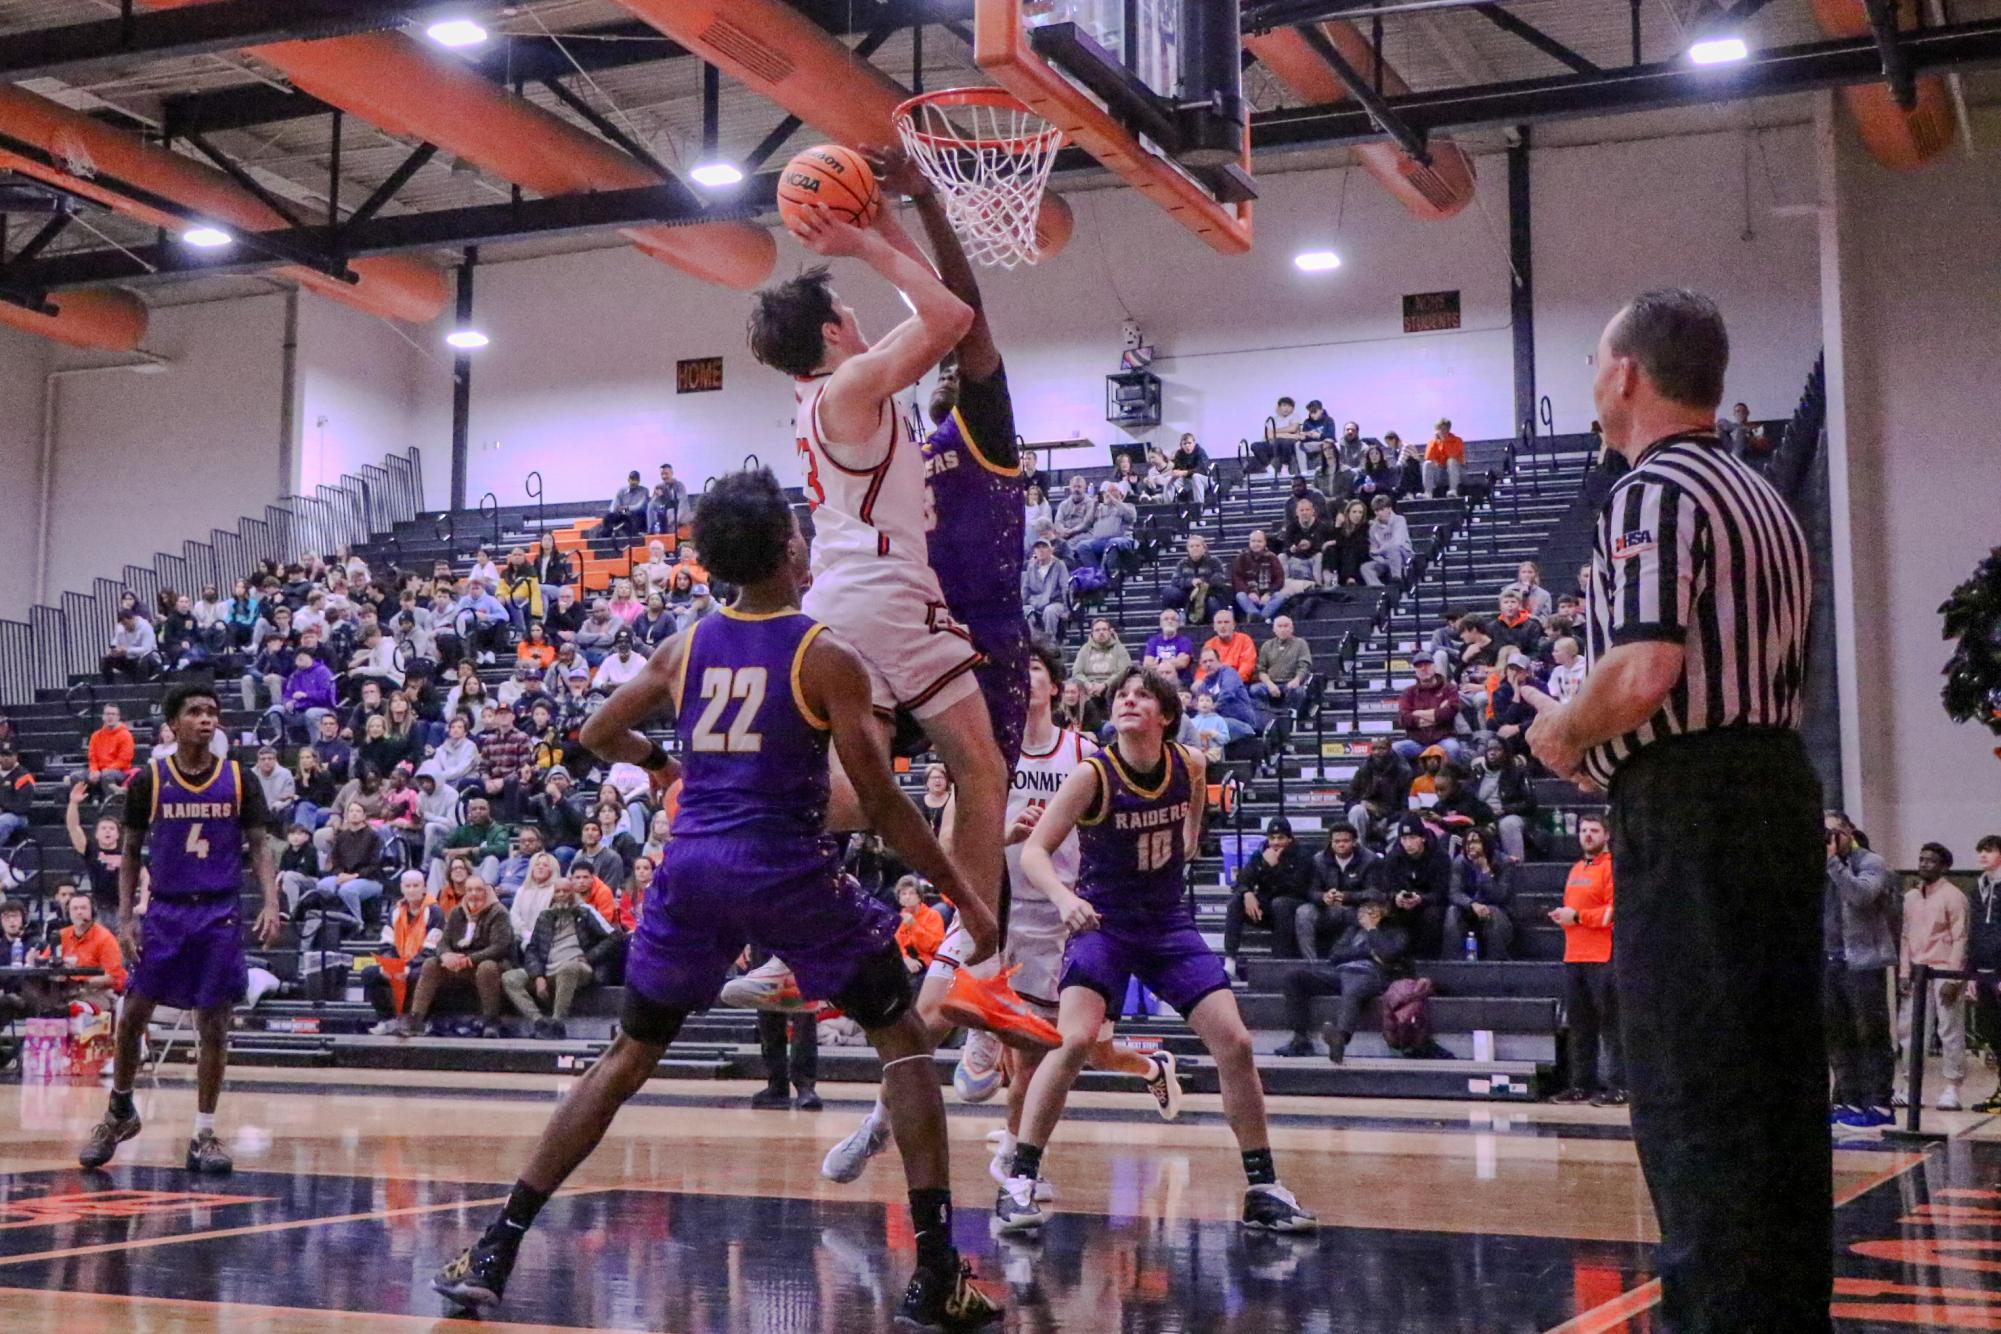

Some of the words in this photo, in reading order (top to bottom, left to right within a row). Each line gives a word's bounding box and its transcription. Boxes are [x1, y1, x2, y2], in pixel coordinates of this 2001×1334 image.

[677, 360, 722, 389] HOME
[692, 667, 768, 752] 22
[162, 803, 232, 819] RAIDERS
[1115, 801, 1190, 830] RAIDERS
[185, 823, 210, 859] 4
[1136, 829, 1173, 872] 10
